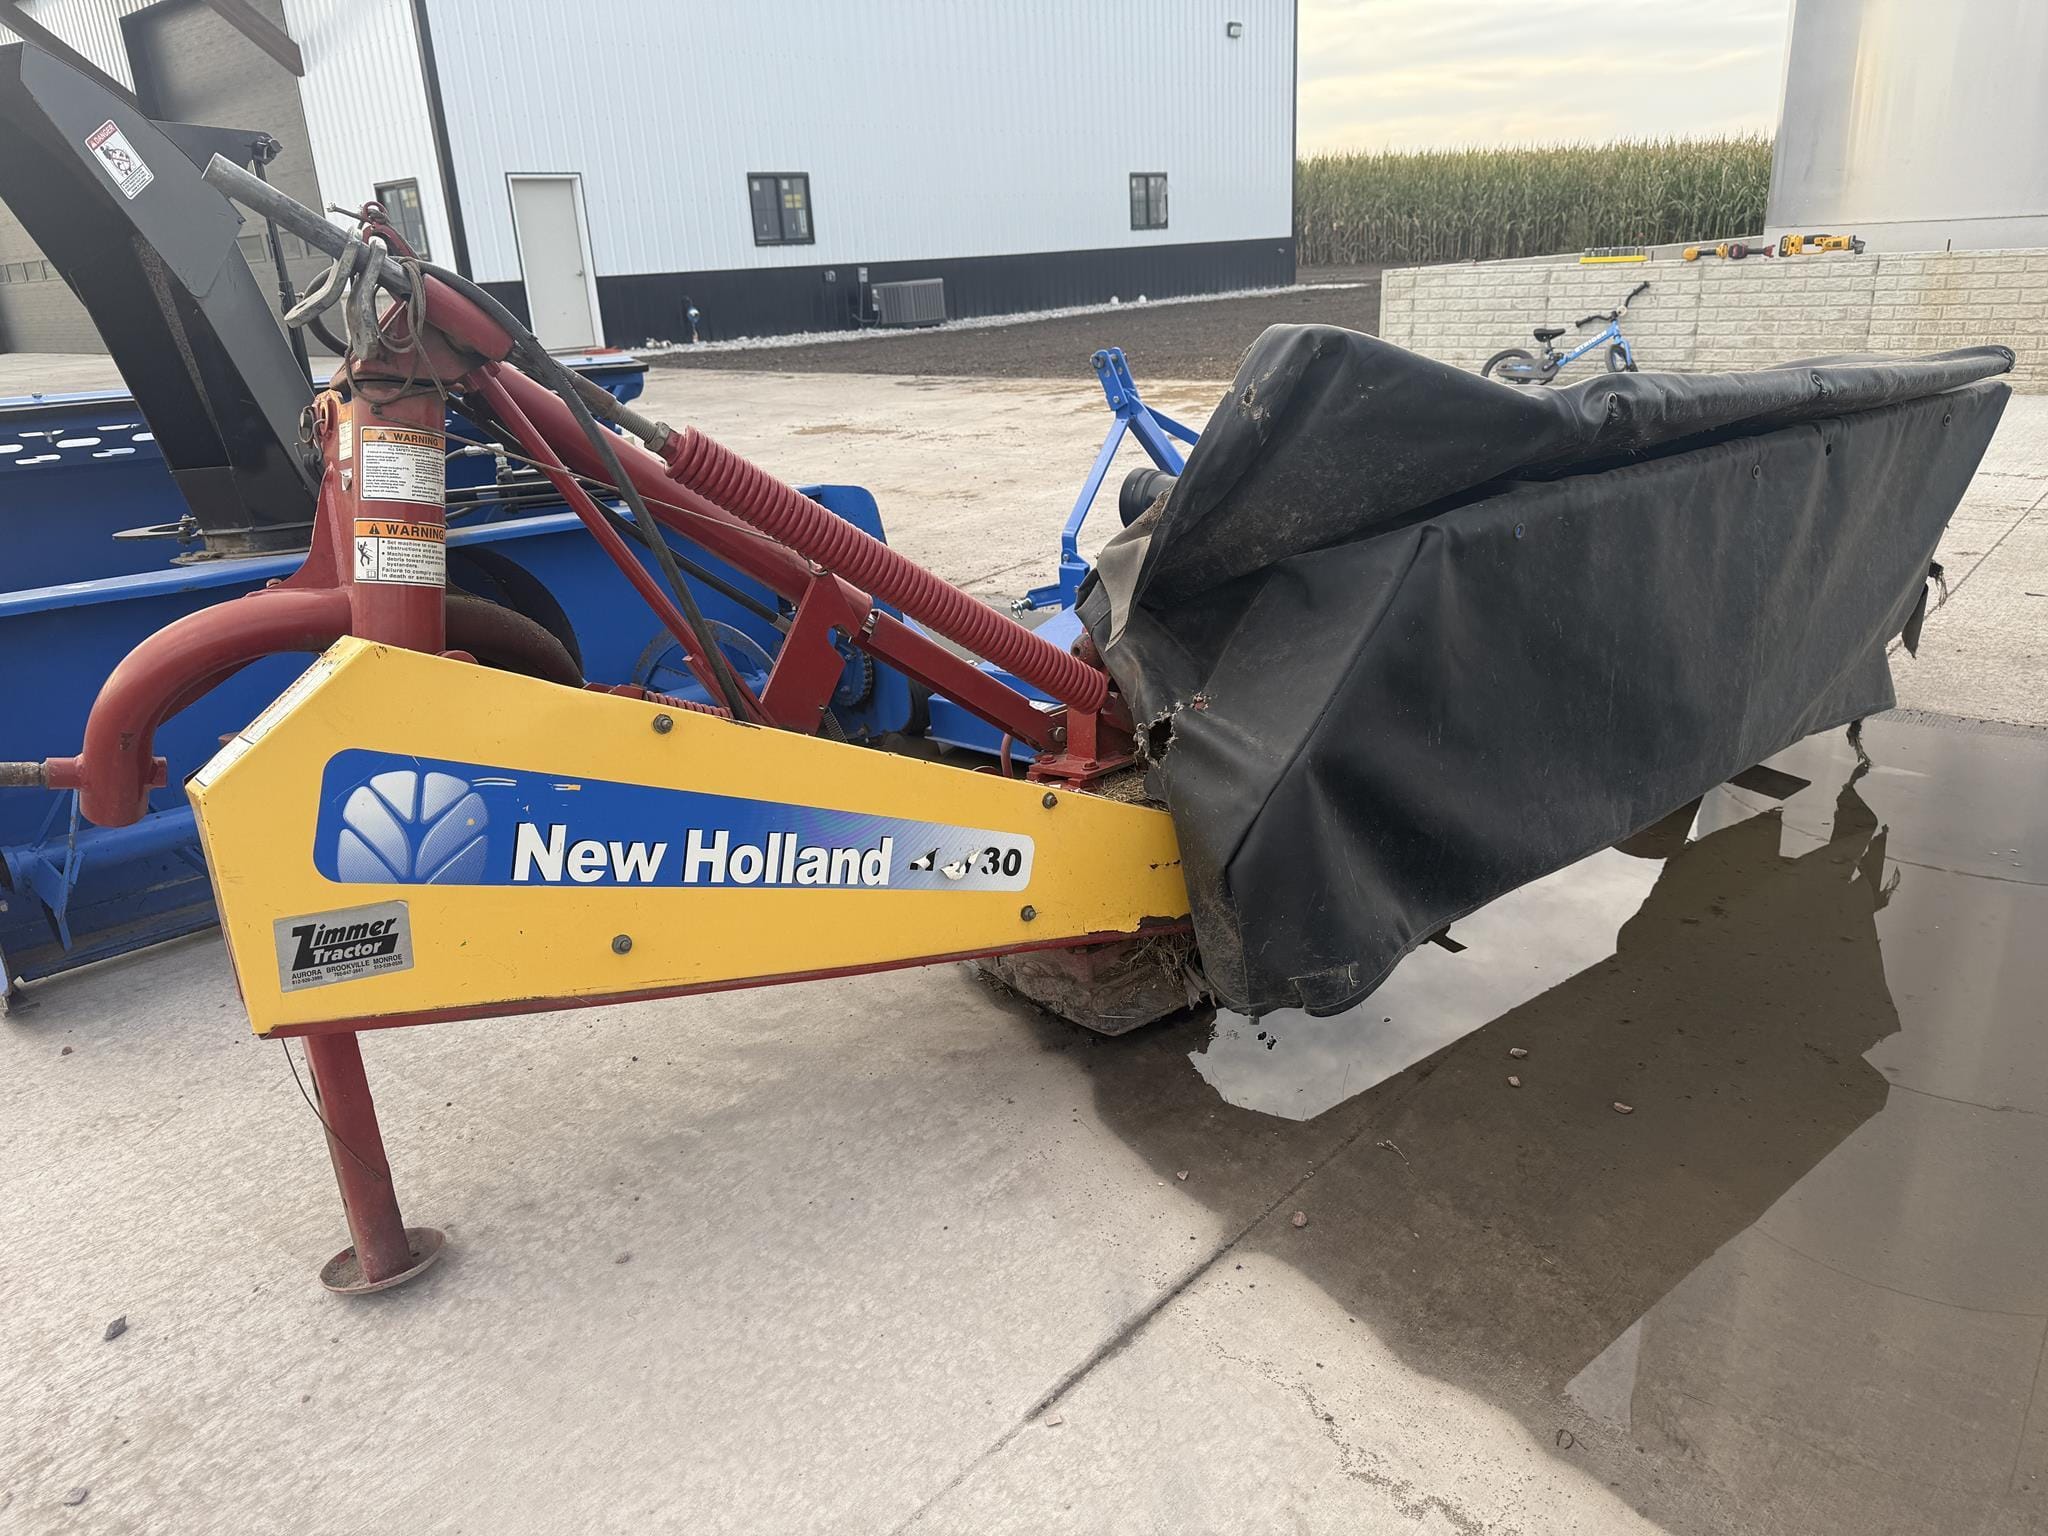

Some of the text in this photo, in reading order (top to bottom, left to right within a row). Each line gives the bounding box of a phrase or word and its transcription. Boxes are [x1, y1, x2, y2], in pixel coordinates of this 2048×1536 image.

[394, 433, 439, 446] WARNING
[386, 524, 444, 540] WARNING
[512, 822, 668, 883] New
[682, 828, 893, 886] Holland
[291, 918, 397, 970] Zimmer
[313, 941, 382, 965] Tractor
[292, 954, 402, 980] AURORA BROOKVILLE MONROE
